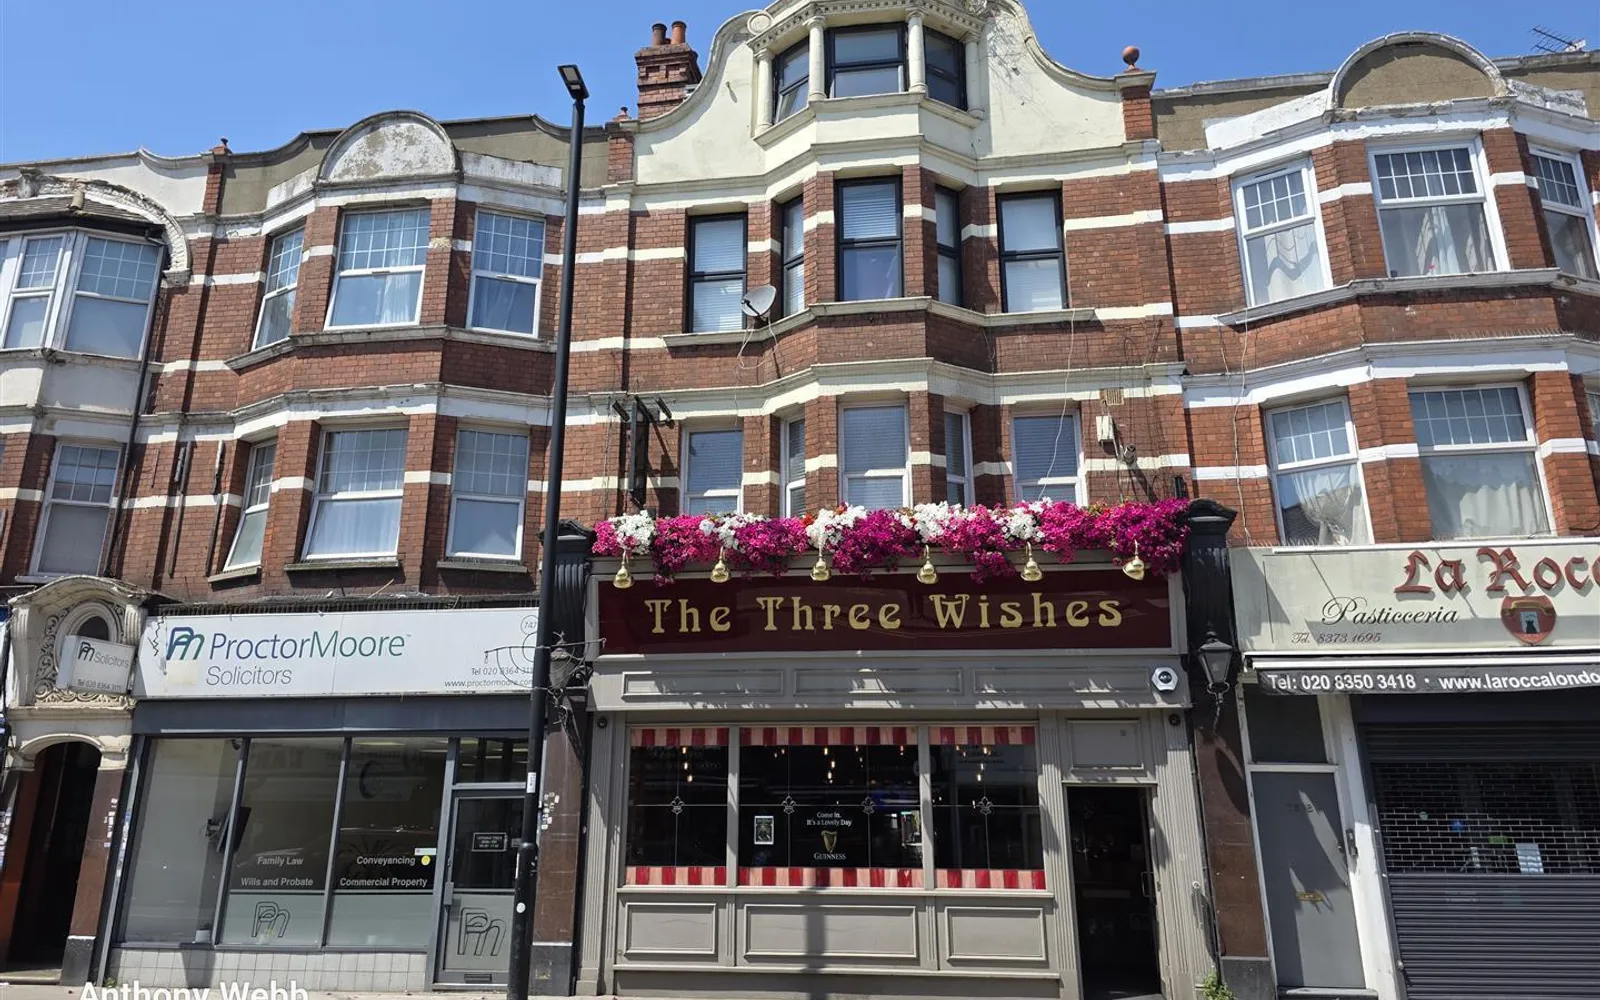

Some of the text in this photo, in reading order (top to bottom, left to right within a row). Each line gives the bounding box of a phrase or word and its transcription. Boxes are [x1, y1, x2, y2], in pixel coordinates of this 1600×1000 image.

[1394, 549, 1467, 594] La
[645, 592, 1123, 634] The Three Wishes
[1321, 596, 1460, 626] Pasticceria
[524, 621, 537, 629] 747
[1351, 632, 1382, 643] 1695
[209, 630, 406, 660] ProctorMoore
[94, 651, 130, 668] Solicitors
[206, 665, 292, 686] Solicitors
[471, 667, 481, 675] Tel
[483, 667, 498, 675] 020
[1267, 674, 1297, 690] Tel:
[1301, 674, 1330, 690] 020
[1334, 674, 1374, 690] 8350
[1376, 673, 1416, 689] 3418
[840, 819, 852, 827] Day
[257, 856, 303, 867] Family Law
[356, 855, 416, 866] Conveyancing
[241, 877, 314, 886] Wills and Probate
[339, 877, 428, 888] Commercial Property
